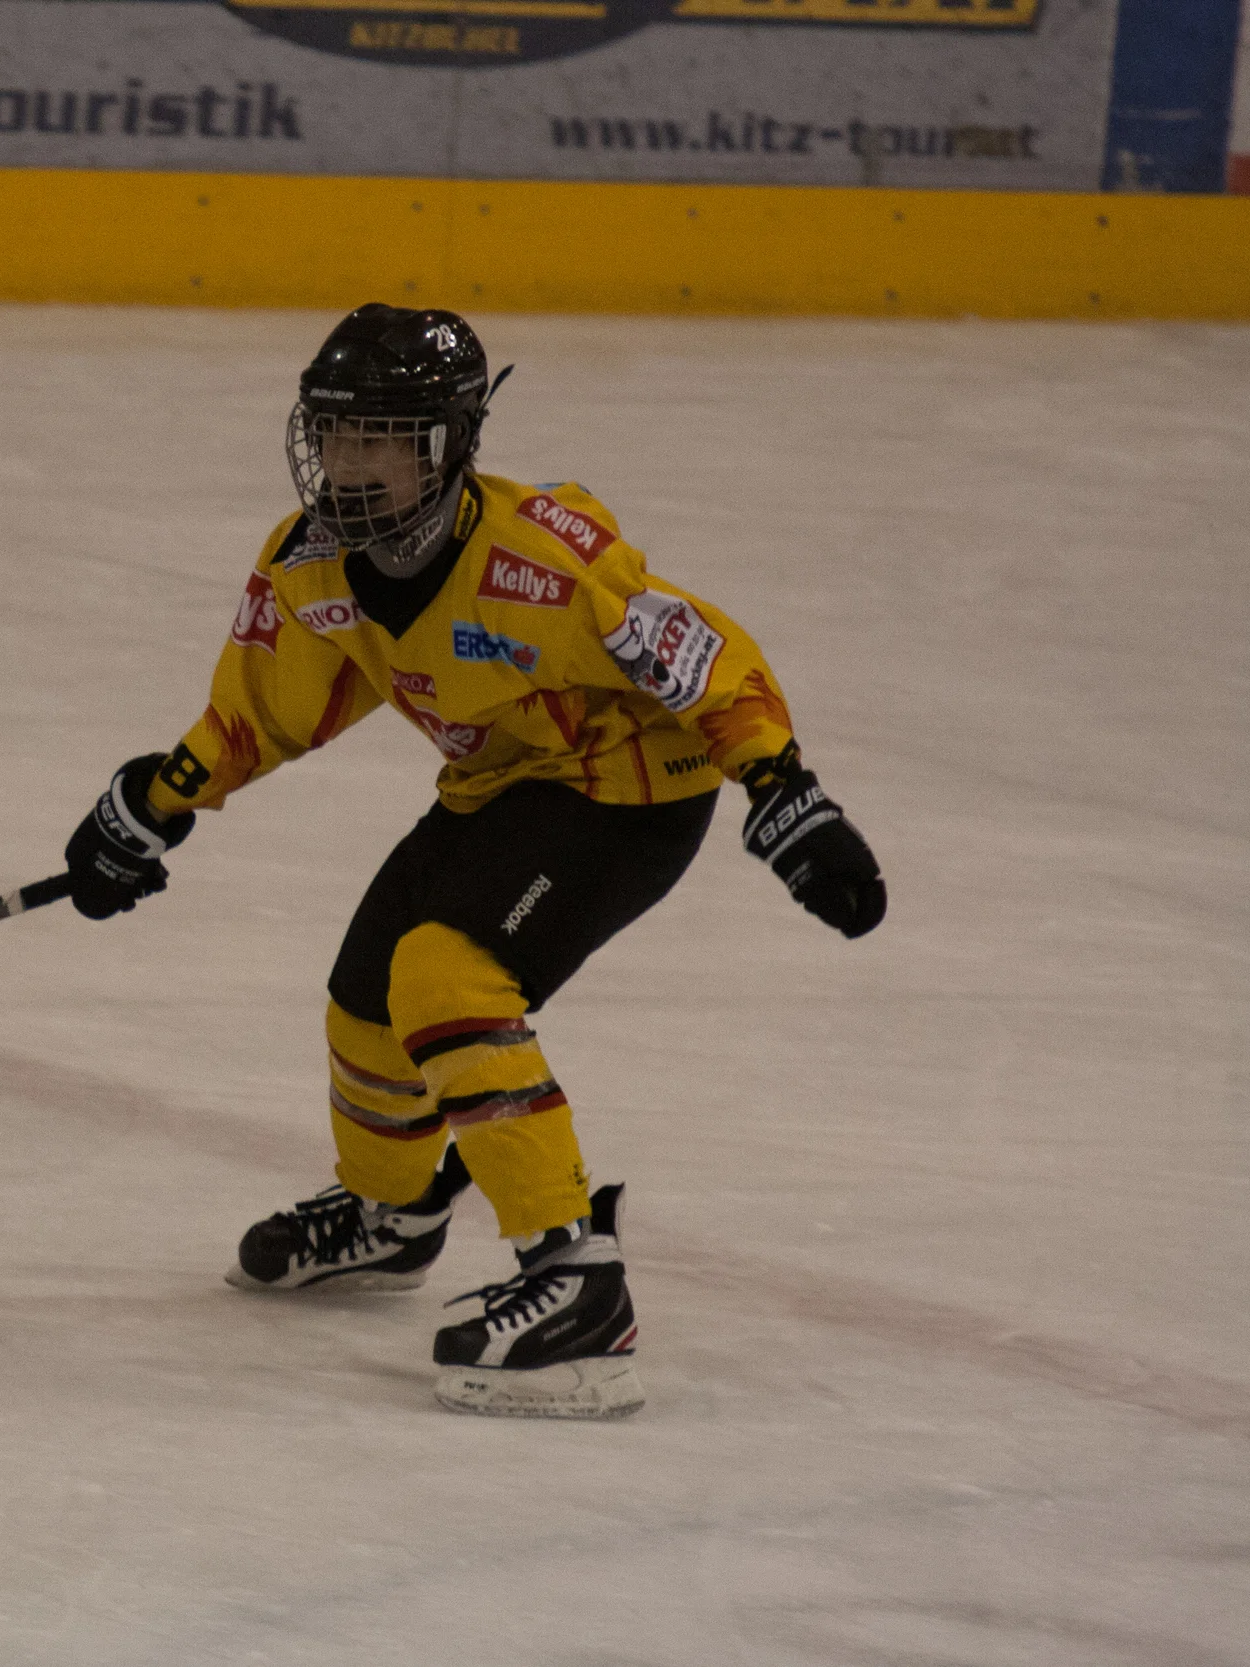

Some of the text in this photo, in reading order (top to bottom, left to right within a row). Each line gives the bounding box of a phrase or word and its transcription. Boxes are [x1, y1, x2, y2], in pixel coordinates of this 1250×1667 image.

[533, 498, 598, 550] Kelly's
[491, 558, 561, 602] Kelly's
[502, 874, 552, 934] Reebok
